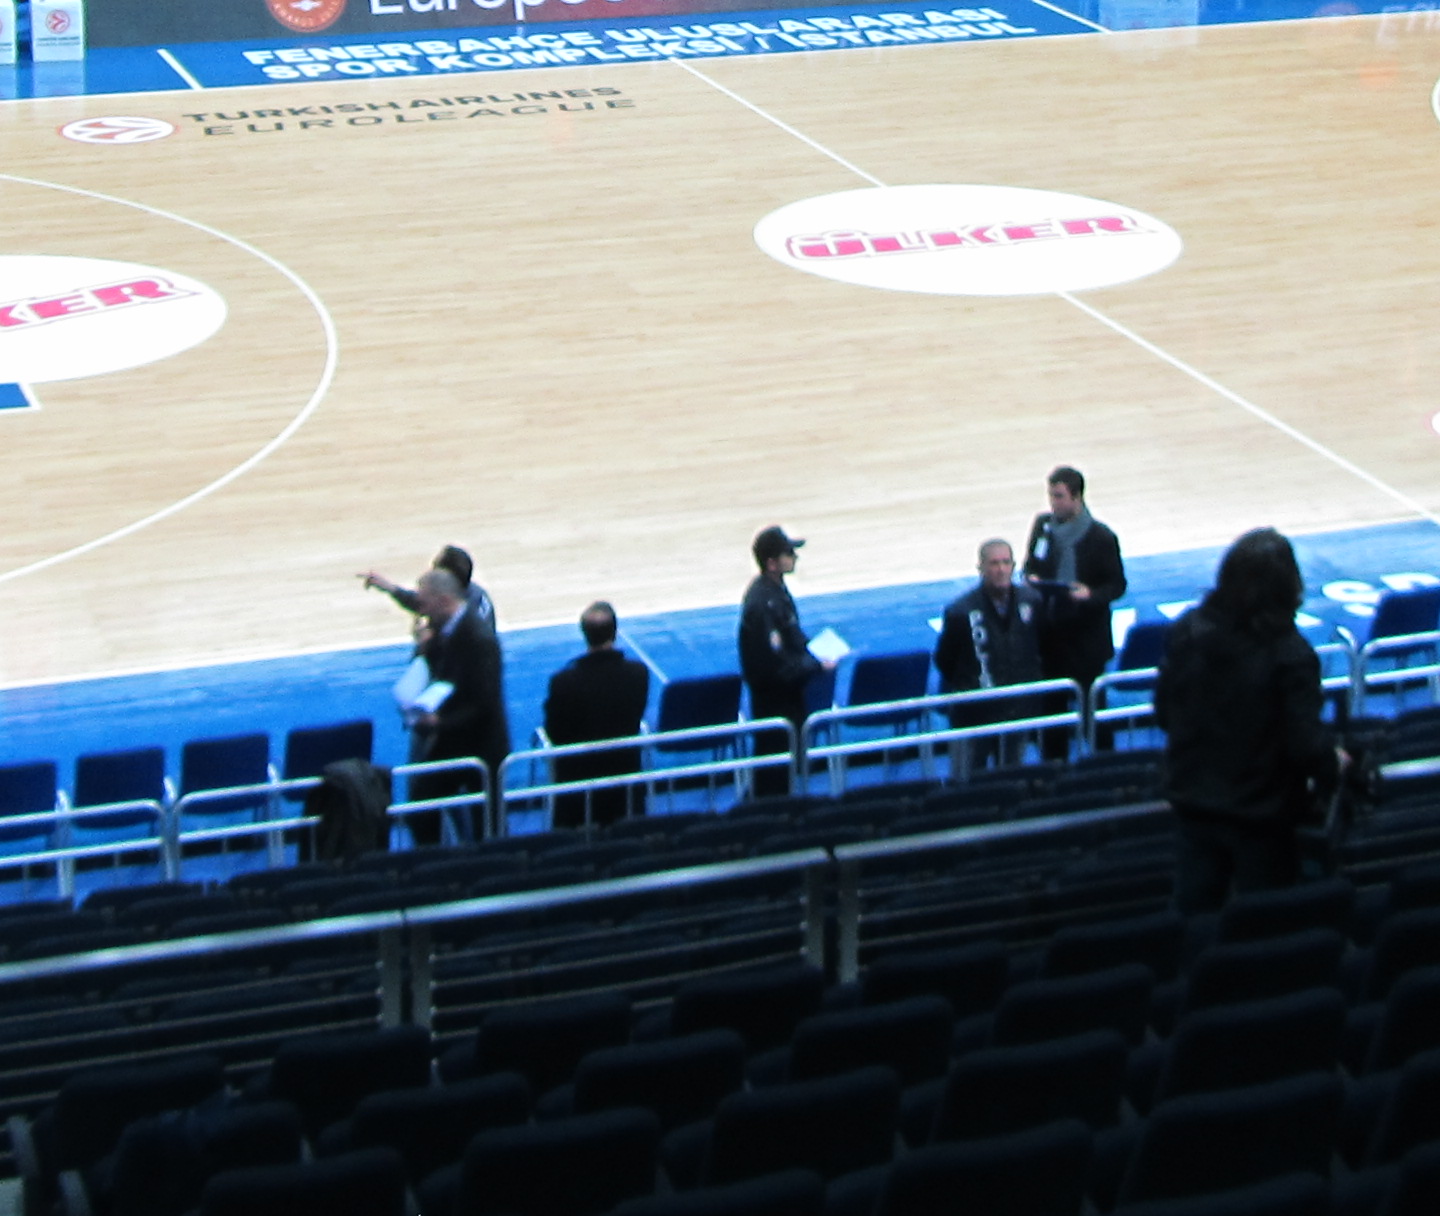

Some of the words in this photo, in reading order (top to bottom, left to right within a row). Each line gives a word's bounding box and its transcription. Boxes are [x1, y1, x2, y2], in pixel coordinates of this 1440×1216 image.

[241, 29, 604, 66] FENERBAHÇE
[603, 6, 1009, 47] ULUSLARARASI
[261, 58, 418, 80] SPOR
[183, 100, 403, 124] TURKISH
[406, 86, 624, 110] AIRLINES
[204, 97, 637, 136] EUROLEAGUE
[785, 214, 1159, 261] ÜLKER
